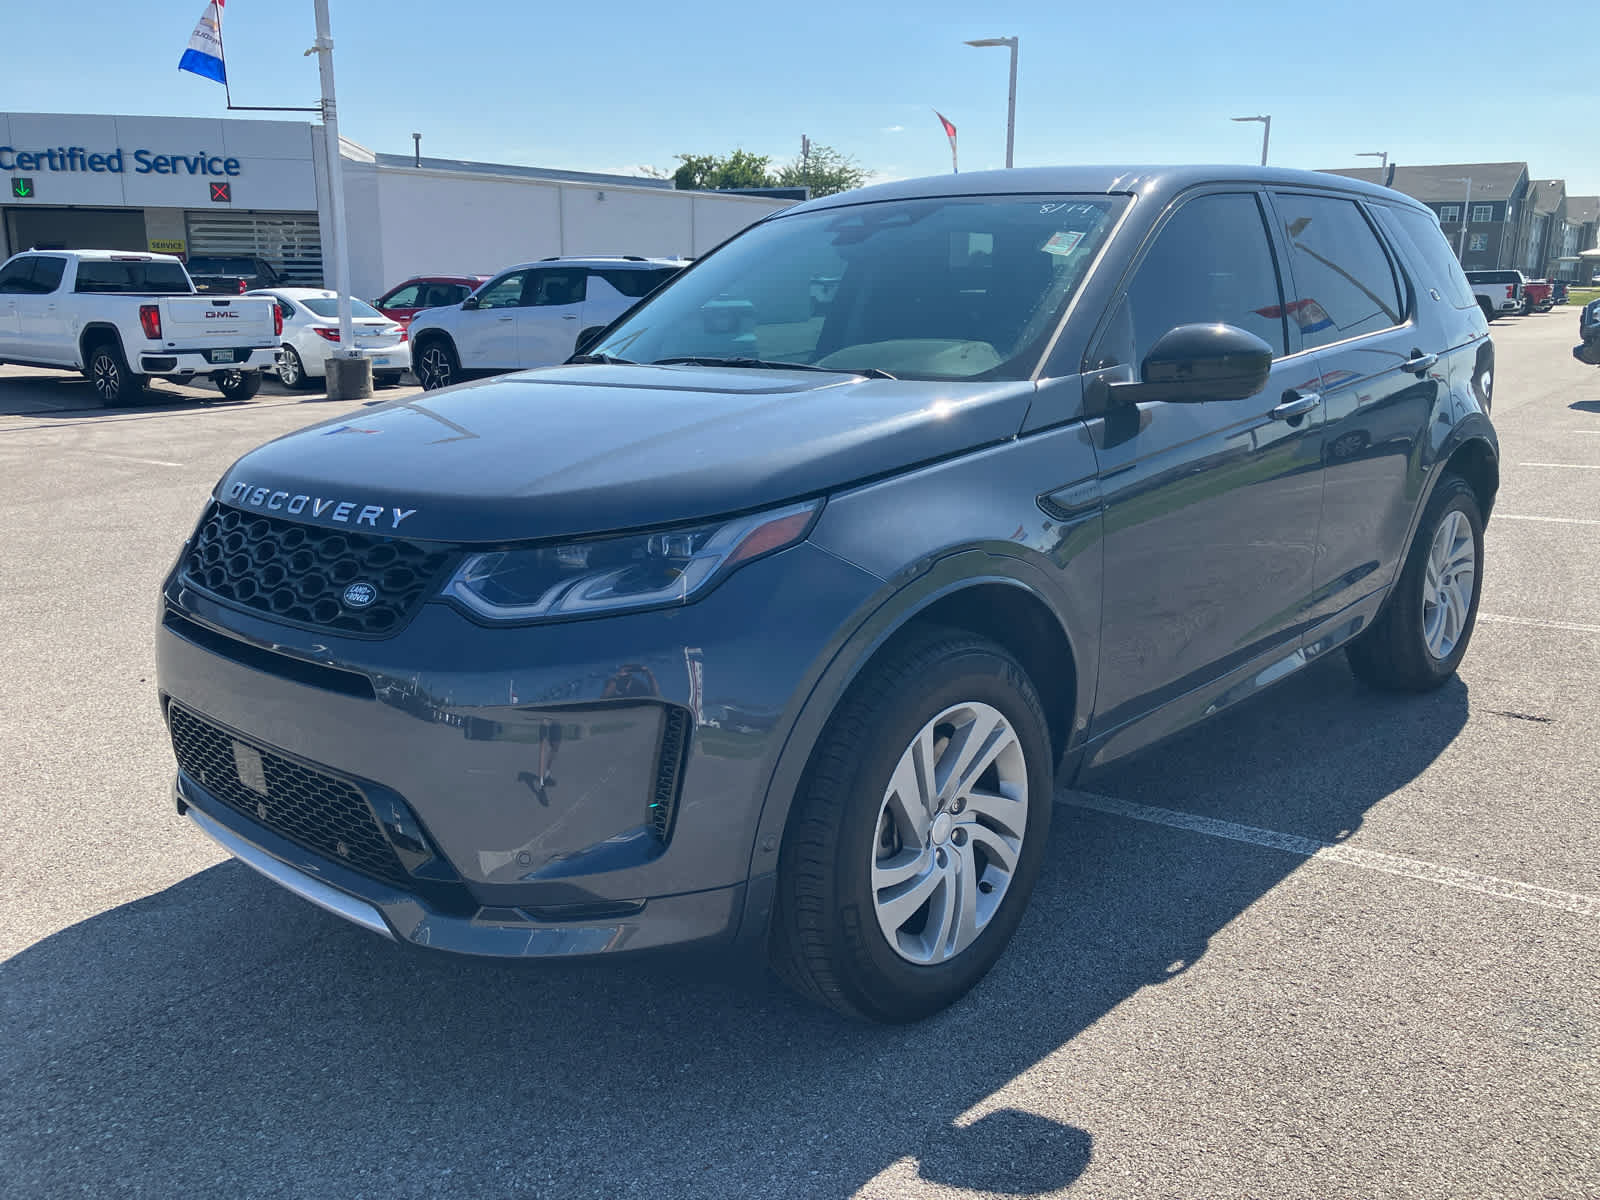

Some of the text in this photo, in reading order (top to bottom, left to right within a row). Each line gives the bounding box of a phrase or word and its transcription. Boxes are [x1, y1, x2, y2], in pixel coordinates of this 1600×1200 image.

[0, 146, 241, 176] Certified Service
[151, 241, 183, 249] SERVICE
[231, 481, 417, 529] DISCOVERY
